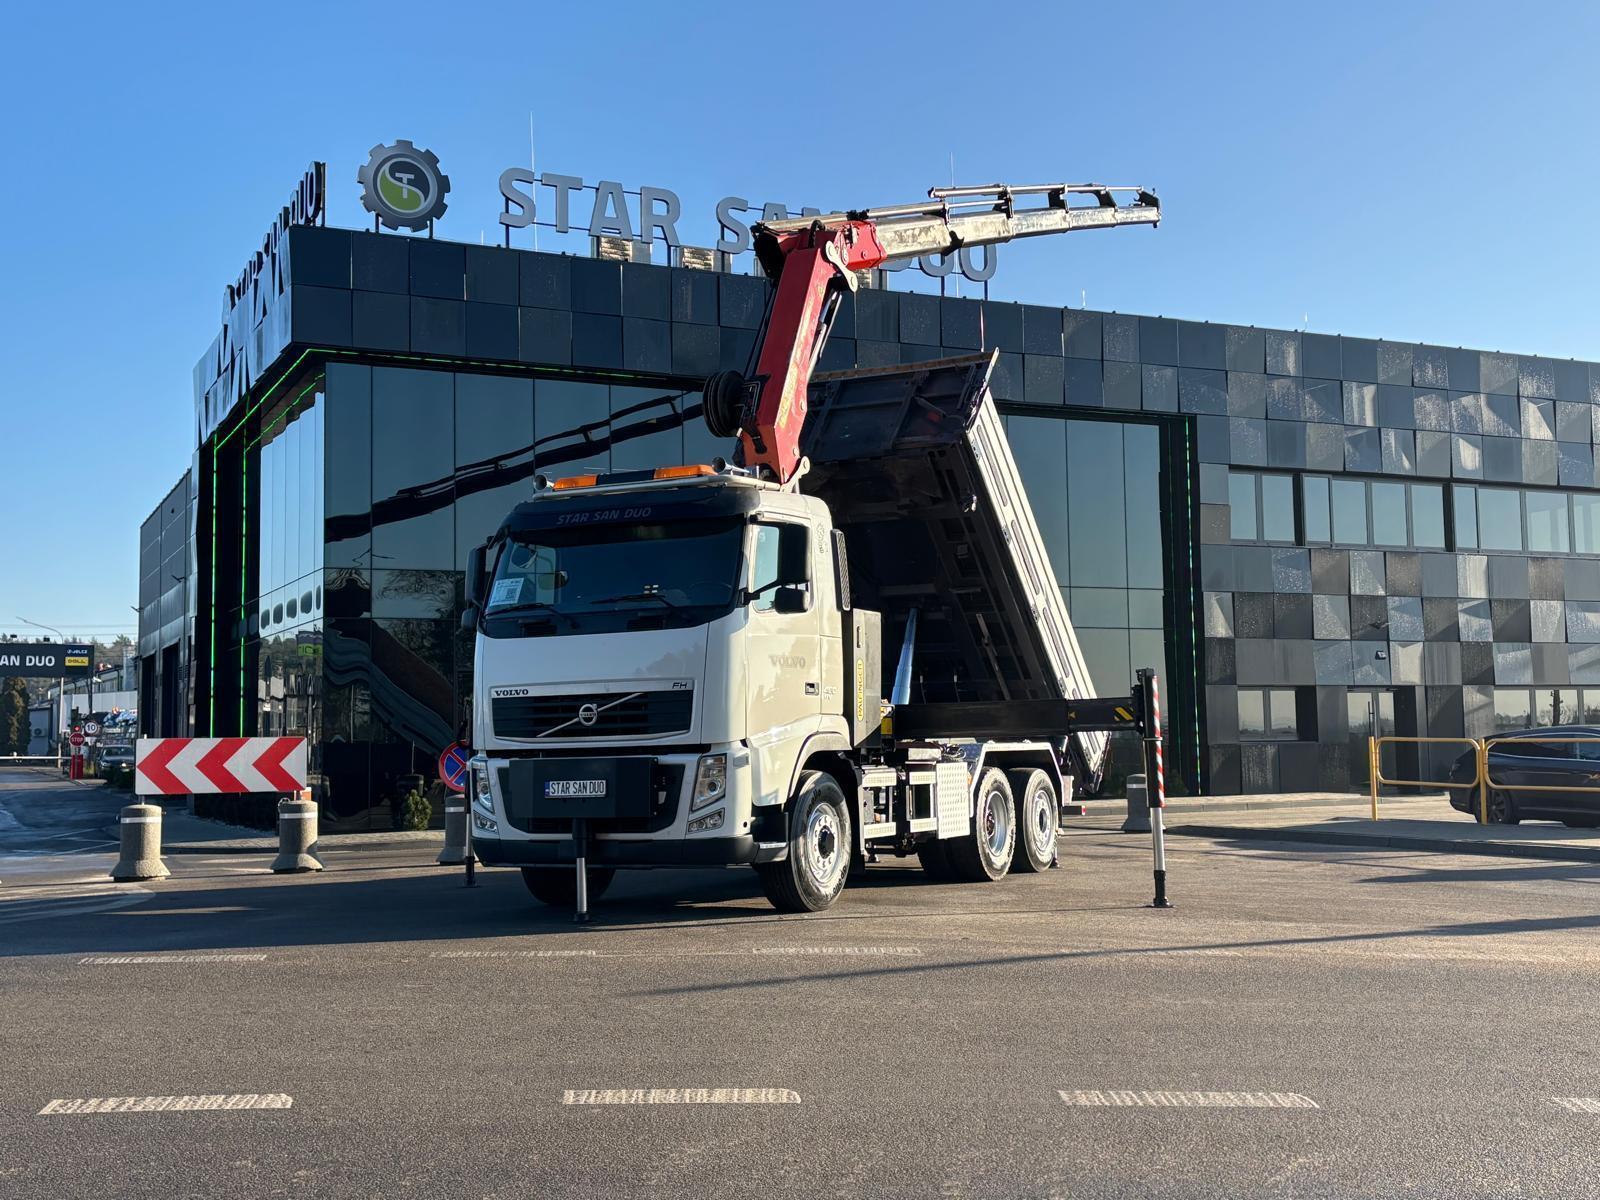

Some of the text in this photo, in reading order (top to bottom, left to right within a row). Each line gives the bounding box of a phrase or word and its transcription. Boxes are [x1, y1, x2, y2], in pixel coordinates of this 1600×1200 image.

[499, 168, 681, 248] STAR
[556, 507, 652, 525] STAR SAN DUO
[25, 655, 55, 667] DUO
[768, 654, 806, 669] VOLVO
[672, 681, 688, 689] FH
[495, 688, 529, 697] VOLVO
[551, 781, 605, 795] STAR SAN DUO
